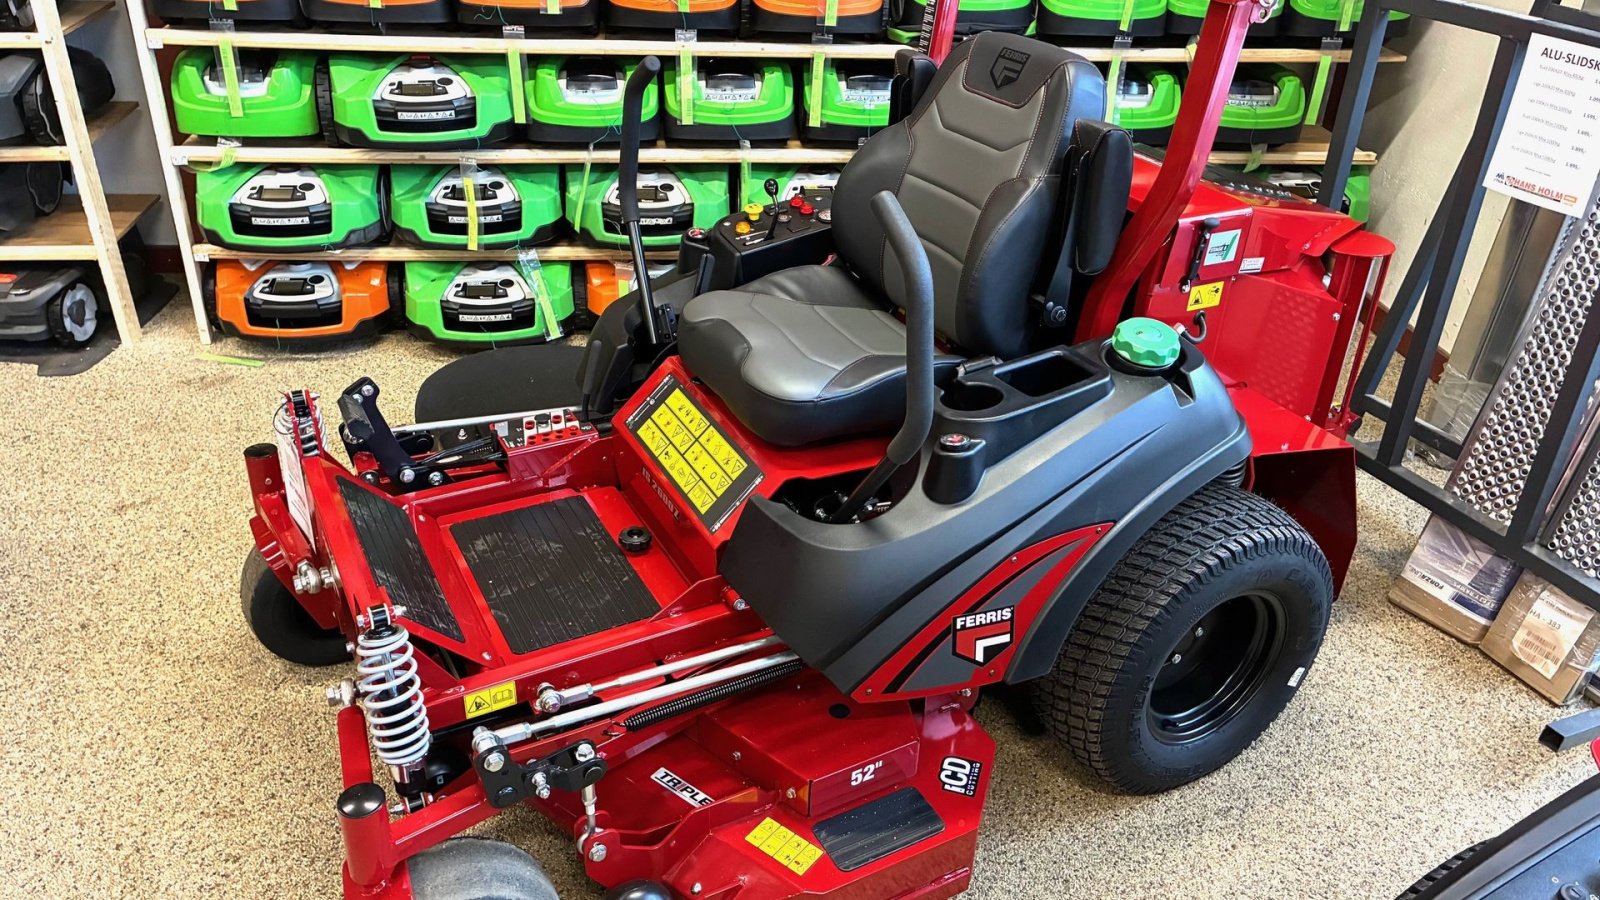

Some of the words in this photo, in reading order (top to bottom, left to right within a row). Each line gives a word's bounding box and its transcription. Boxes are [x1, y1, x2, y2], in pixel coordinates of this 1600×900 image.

[1001, 49, 1029, 62] FERRIS
[1514, 178, 1536, 191] HANS
[1538, 187, 1563, 200] HOLM
[956, 607, 1012, 630] FERRIS
[850, 760, 883, 786] 52"
[966, 763, 980, 795] CUTTING
[660, 771, 713, 806] TRIPLE
